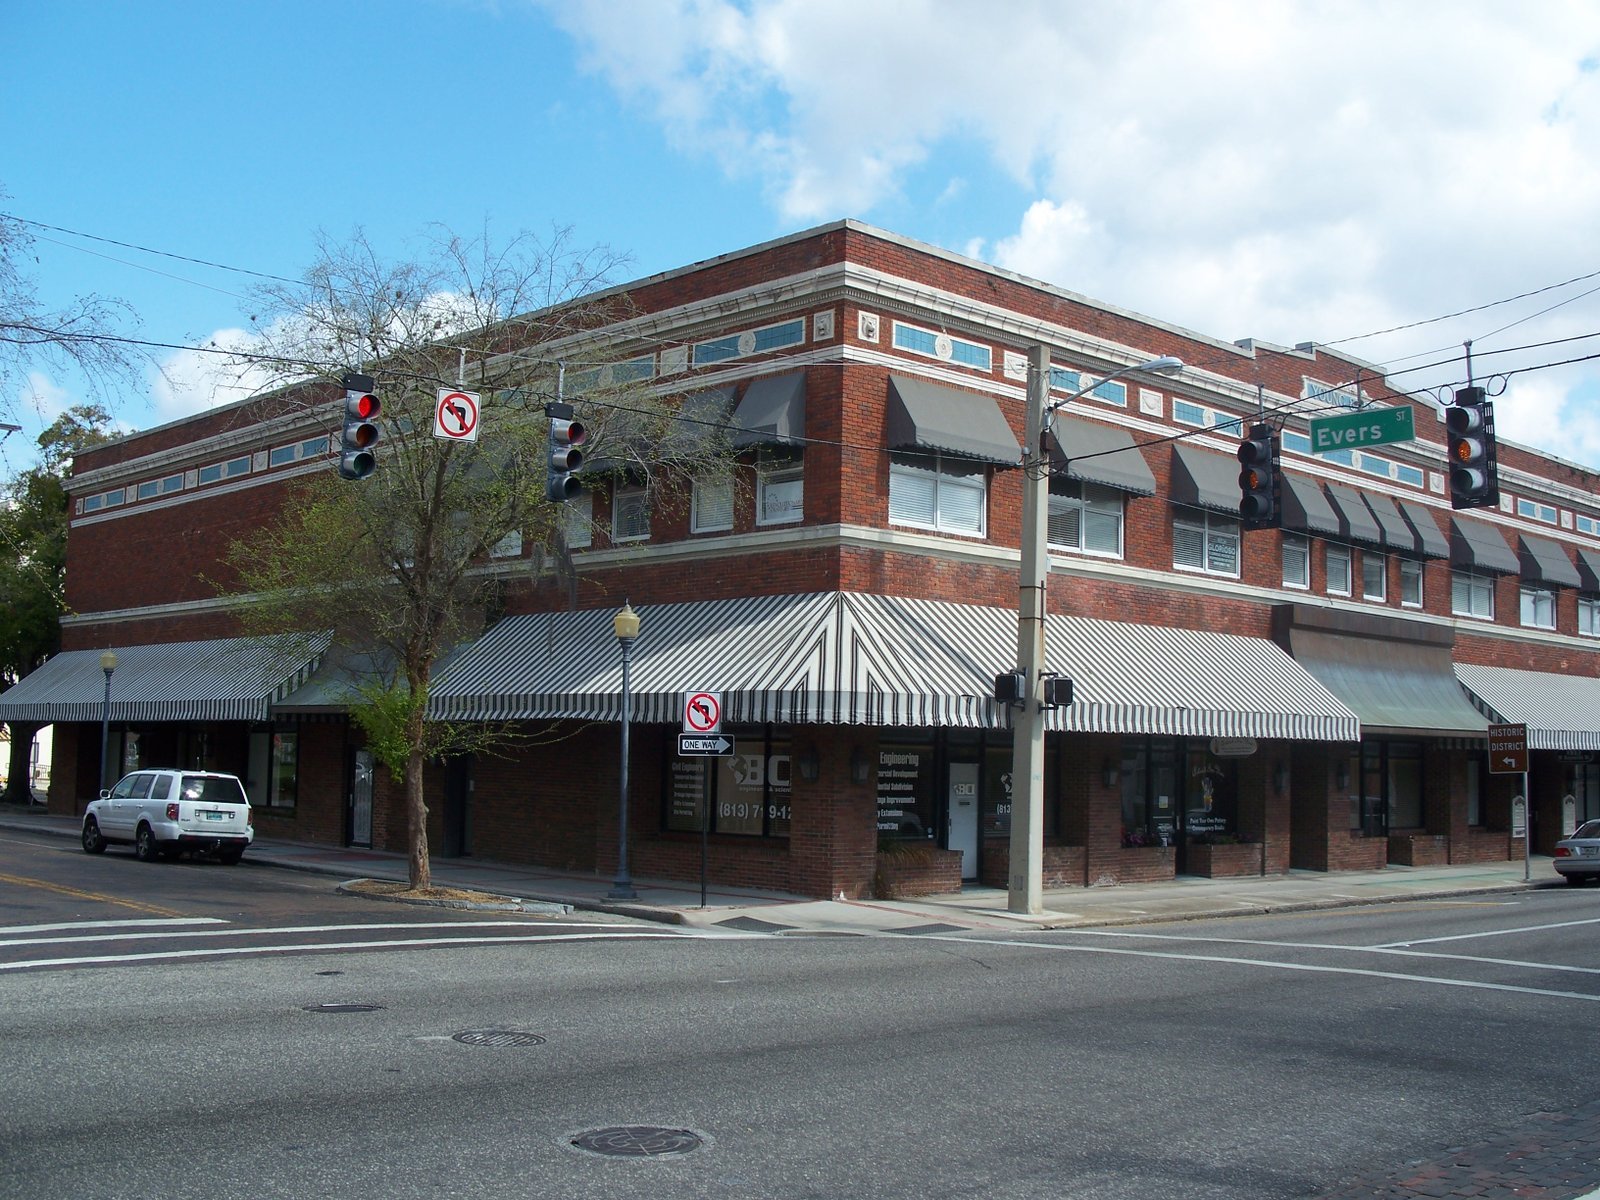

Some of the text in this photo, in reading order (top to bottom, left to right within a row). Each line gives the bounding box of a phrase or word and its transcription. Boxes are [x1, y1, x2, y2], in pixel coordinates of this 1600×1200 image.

[1395, 411, 1405, 422] ST
[1317, 424, 1382, 447] Evers
[1490, 727, 1524, 737] HISTORIC
[684, 740, 717, 749] ONE WAY
[1491, 742, 1524, 751] DISTRICT
[880, 751, 919, 767] Engineering
[719, 802, 749, 820] (813)
